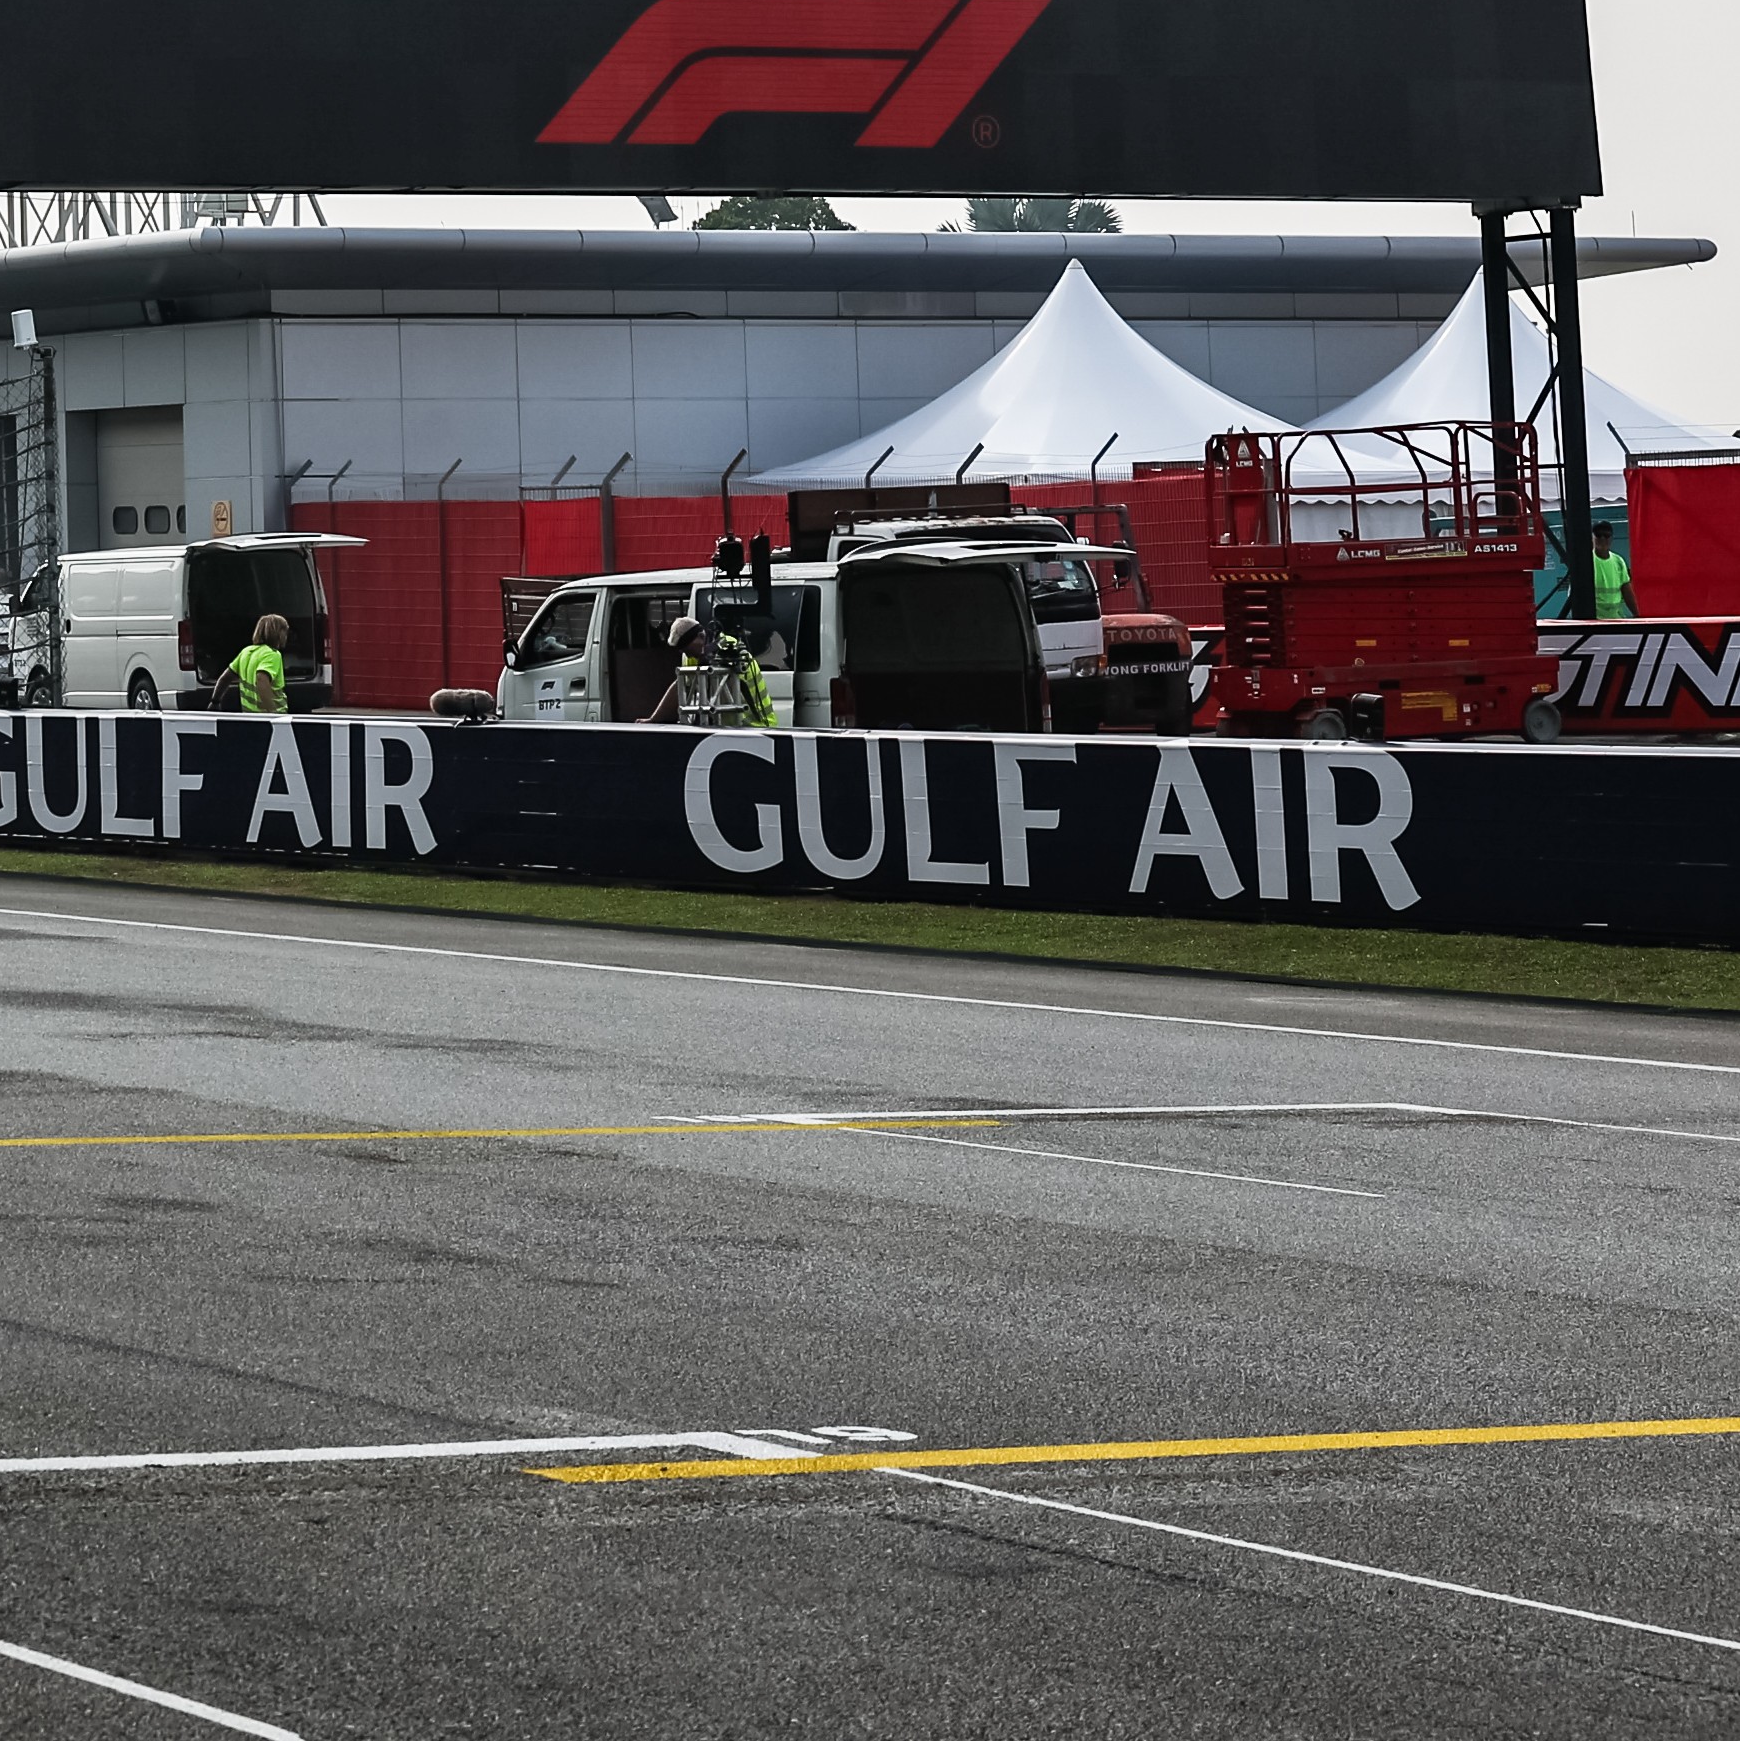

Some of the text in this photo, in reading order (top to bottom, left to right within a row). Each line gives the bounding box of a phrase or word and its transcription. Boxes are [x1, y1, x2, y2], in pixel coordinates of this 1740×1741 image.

[1474, 544, 1518, 553] AS1413
[1107, 628, 1176, 642] TOYOTA
[1143, 662, 1190, 674] FORKLIFT
[246, 716, 437, 855] AIR
[684, 734, 1421, 911] GULF AIR
